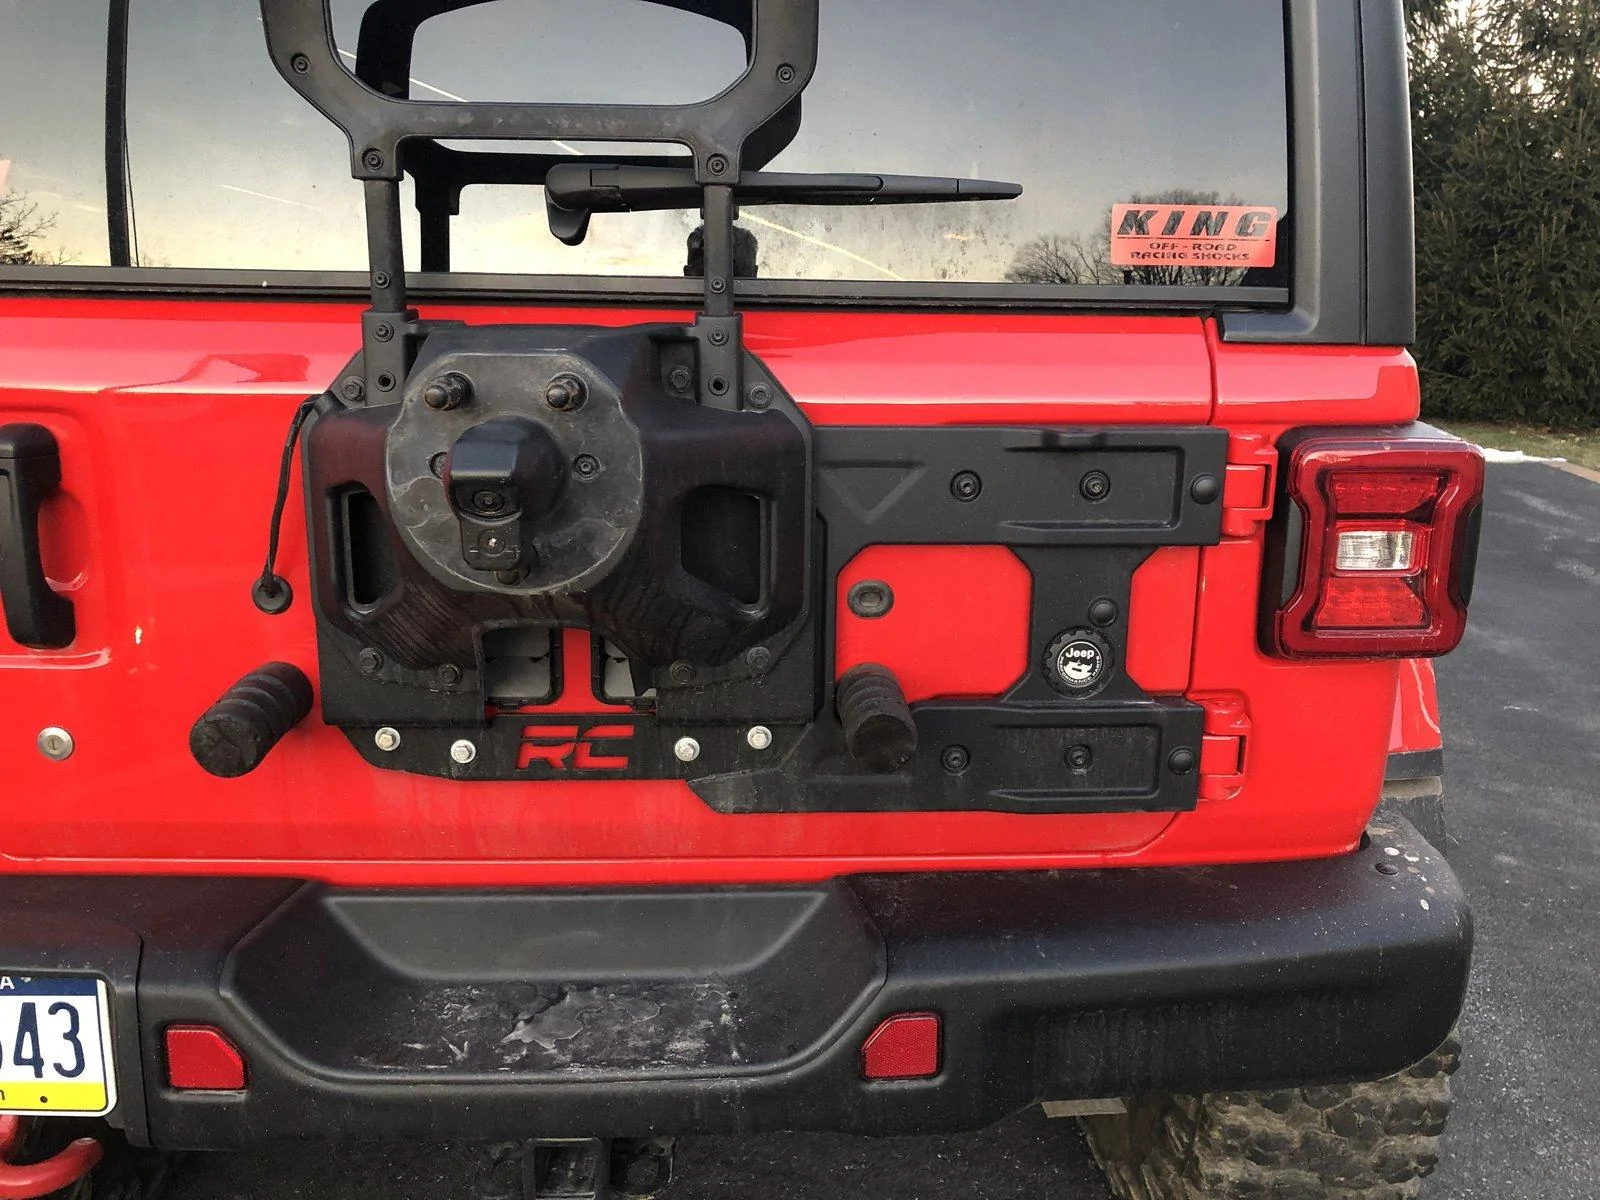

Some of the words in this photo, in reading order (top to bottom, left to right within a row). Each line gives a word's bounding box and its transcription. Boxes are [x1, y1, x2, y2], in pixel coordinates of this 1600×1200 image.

[1117, 210, 1272, 237] KING
[1130, 251, 1188, 260] RACING
[1192, 252, 1250, 261] SHOCKS
[1065, 648, 1095, 659] Jeep
[515, 725, 635, 771] RC
[0, 1001, 86, 1079] 43
